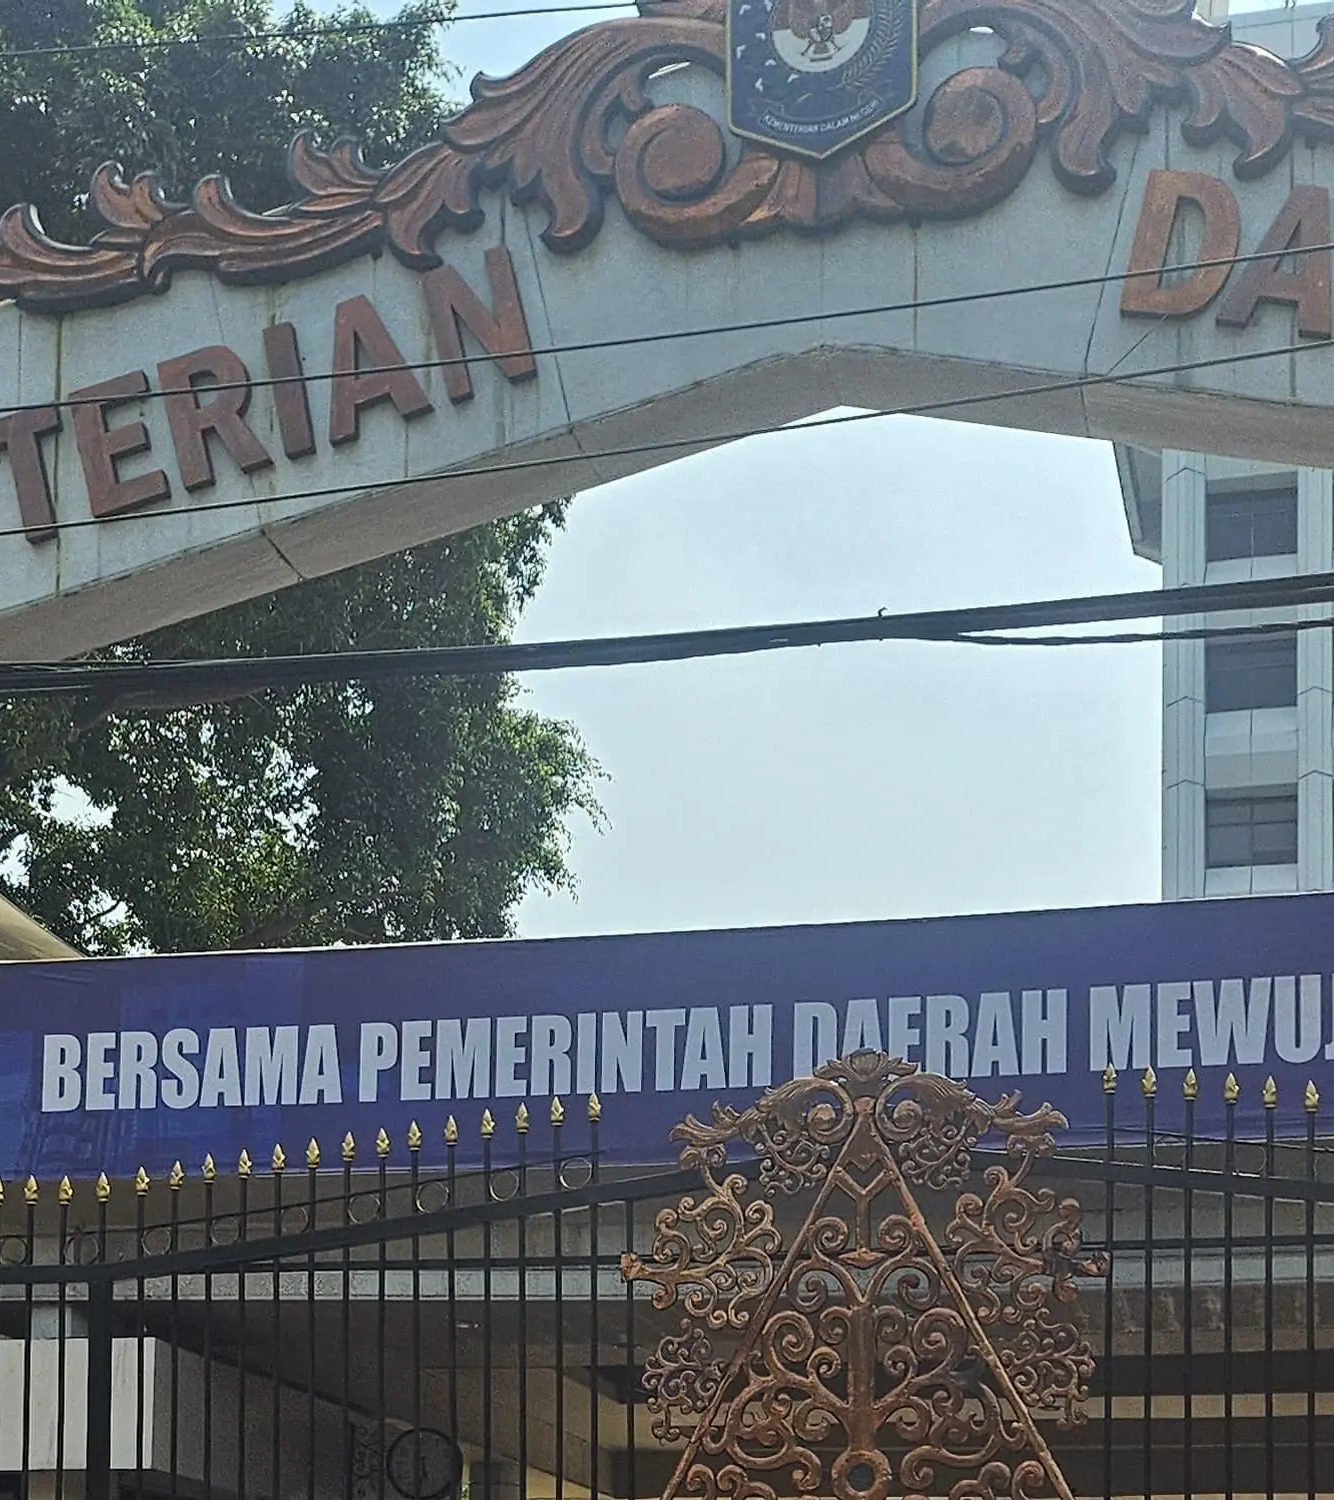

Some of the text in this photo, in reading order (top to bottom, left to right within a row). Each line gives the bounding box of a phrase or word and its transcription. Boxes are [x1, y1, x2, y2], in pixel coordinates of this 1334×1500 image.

[41, 1023, 344, 1114] BERSAMA
[358, 1001, 775, 1103] PEMERINTAH
[793, 988, 1067, 1082] DAERAH
